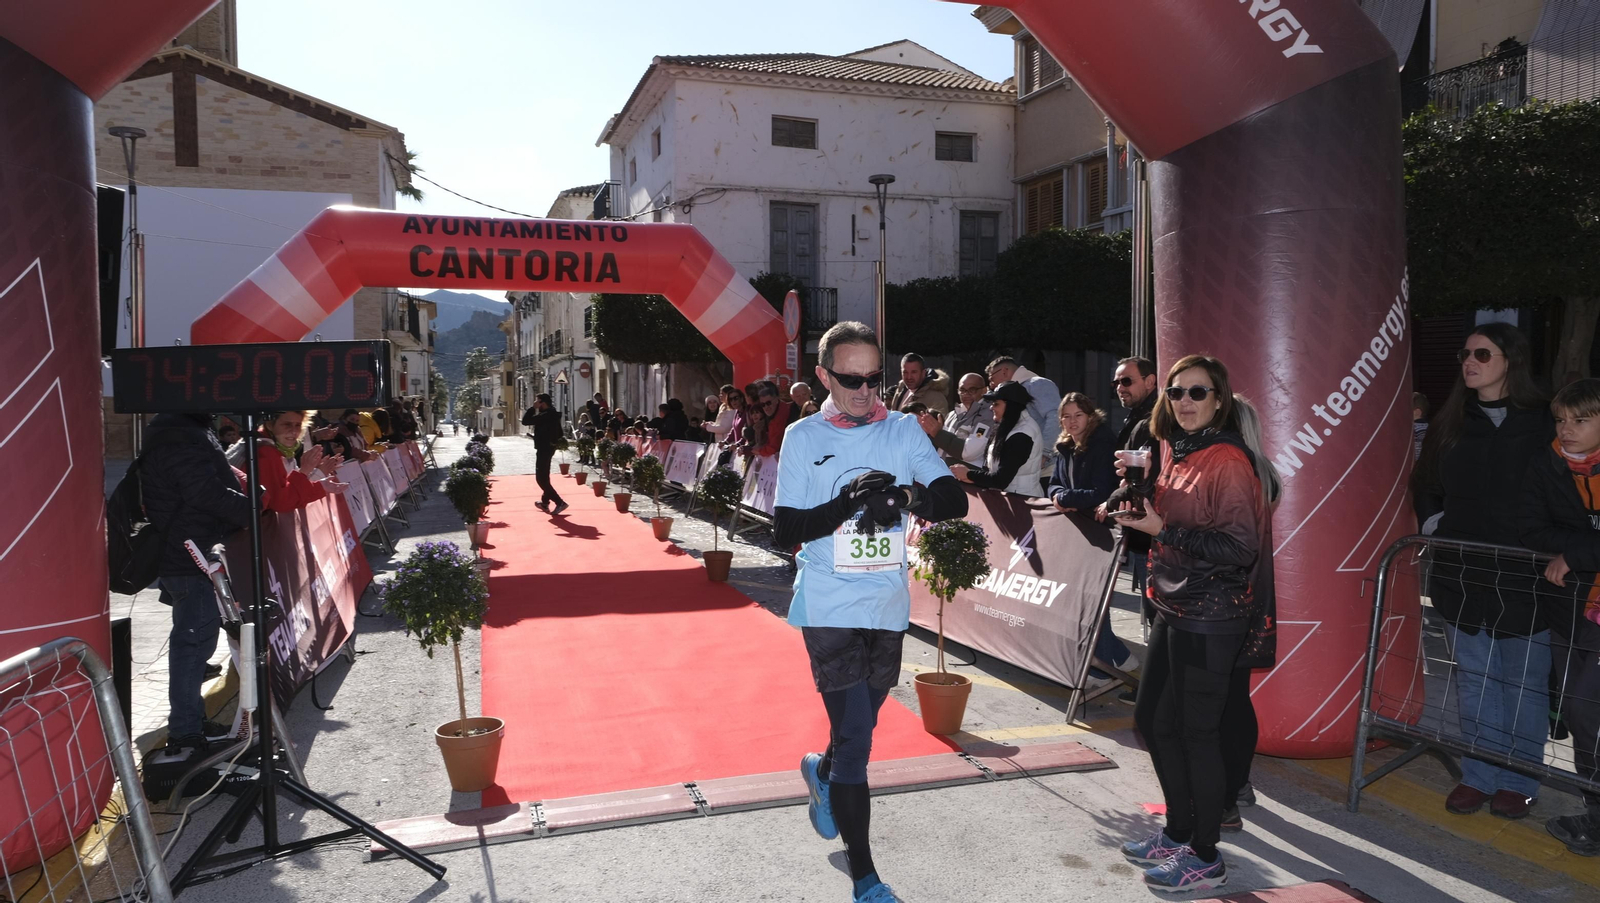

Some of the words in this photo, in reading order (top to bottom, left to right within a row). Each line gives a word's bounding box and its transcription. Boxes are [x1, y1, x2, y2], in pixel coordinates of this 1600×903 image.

[402, 216, 628, 242] AYUNTAMIENTO
[409, 244, 621, 283] CANTORIA
[850, 536, 891, 559] 358
[974, 603, 1025, 627] www.teamergy.es
